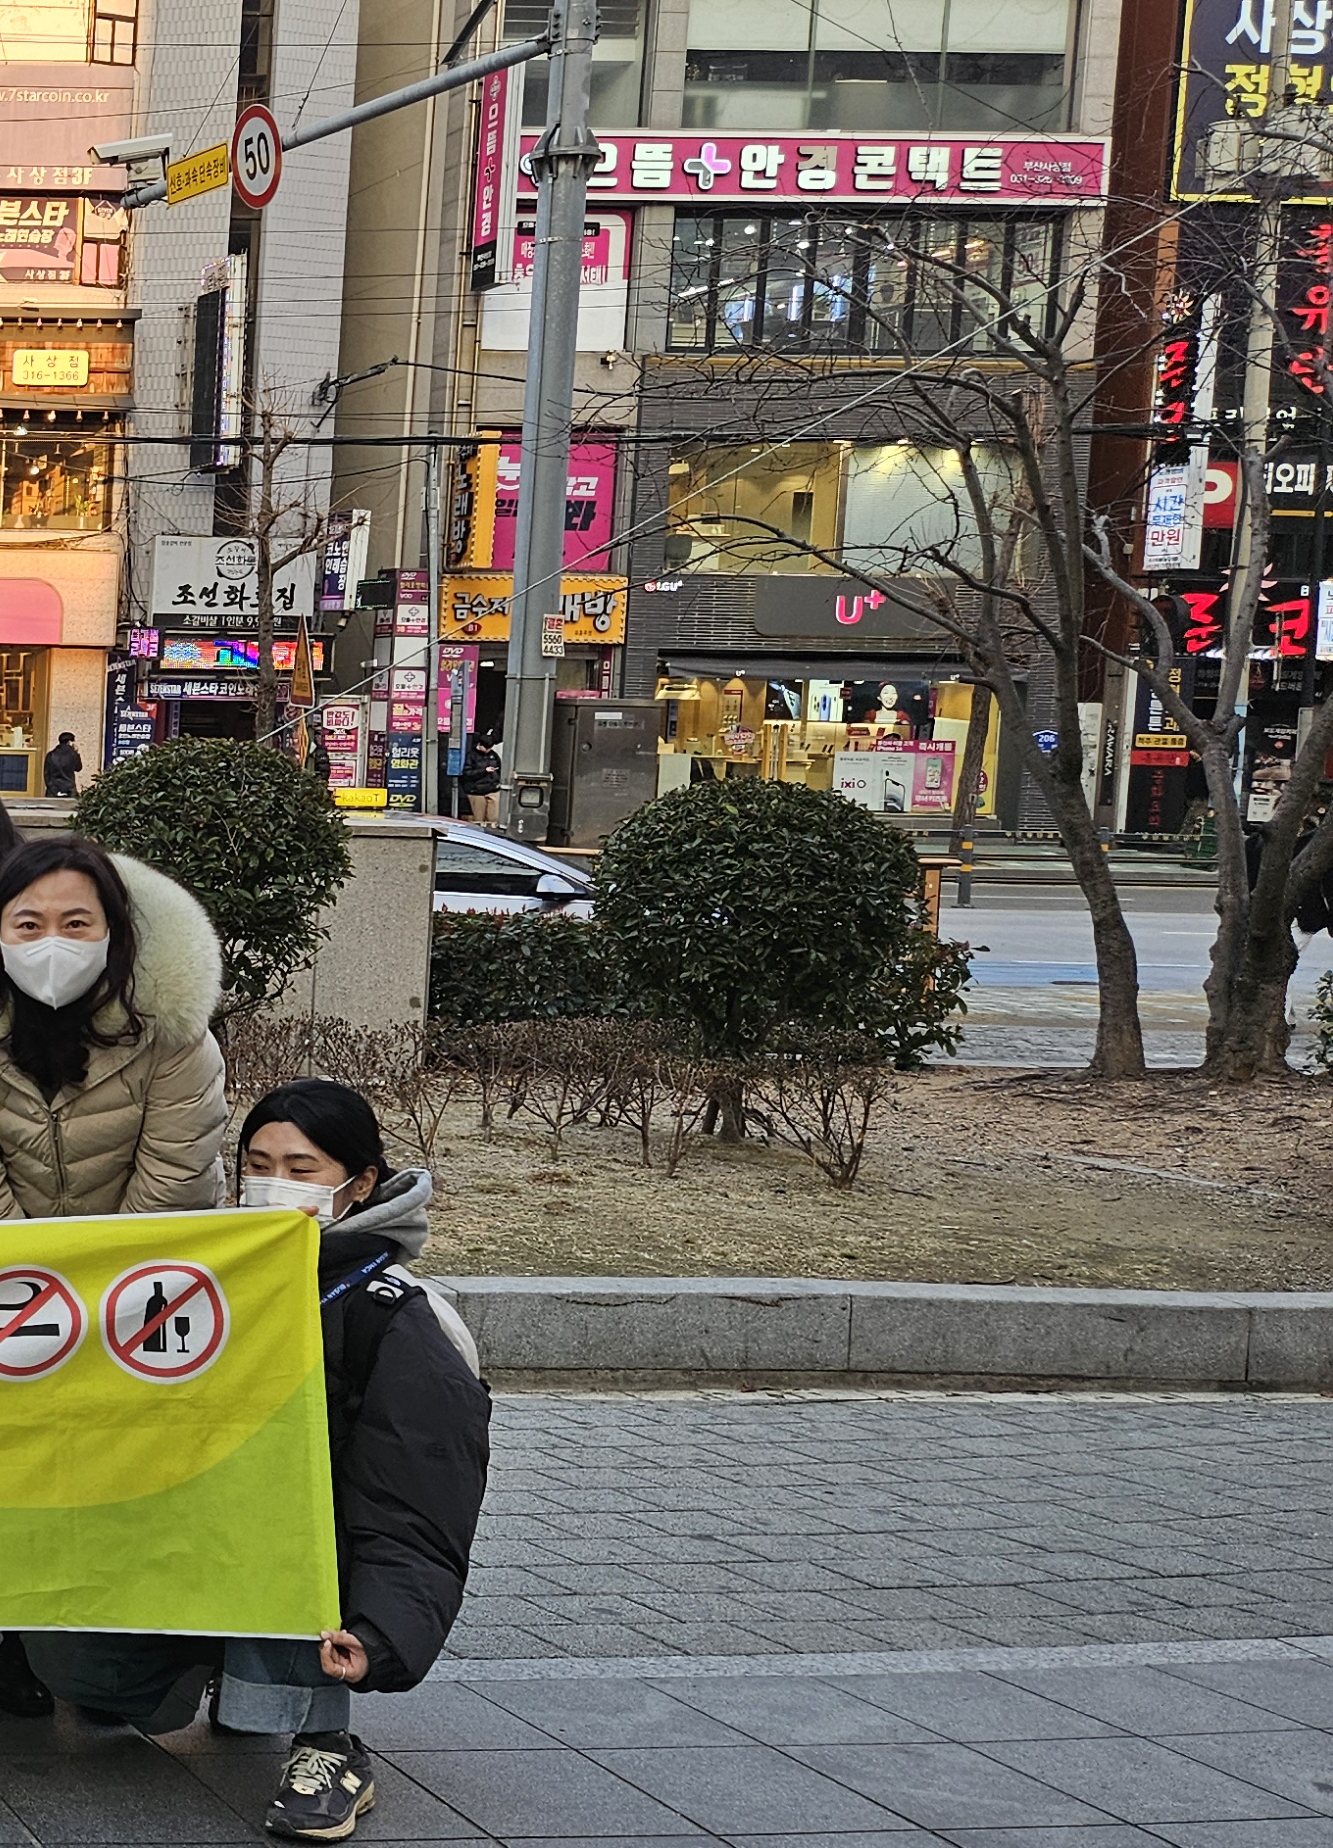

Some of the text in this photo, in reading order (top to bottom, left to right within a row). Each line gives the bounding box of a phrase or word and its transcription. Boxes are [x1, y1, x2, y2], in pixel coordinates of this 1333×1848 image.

[244, 131, 270, 181] 50
[853, 144, 1005, 192] 콘택트
[1023, 160, 1072, 173] 부산사상점
[6, 166, 69, 185] 사상점
[71, 167, 93, 186] 3F
[23, 353, 81, 369] 사상점
[23, 369, 80, 381] 316-1366
[1150, 528, 1181, 547] 만원
[453, 591, 512, 620] 금수저
[835, 589, 887, 625] U+
[183, 614, 217, 627] 소갈비살
[543, 634, 563, 645] 5560
[542, 646, 564, 655] 4433
[183, 681, 219, 697] 세븐스타
[1038, 734, 1056, 742] 206
[389, 794, 417, 804] DVD
